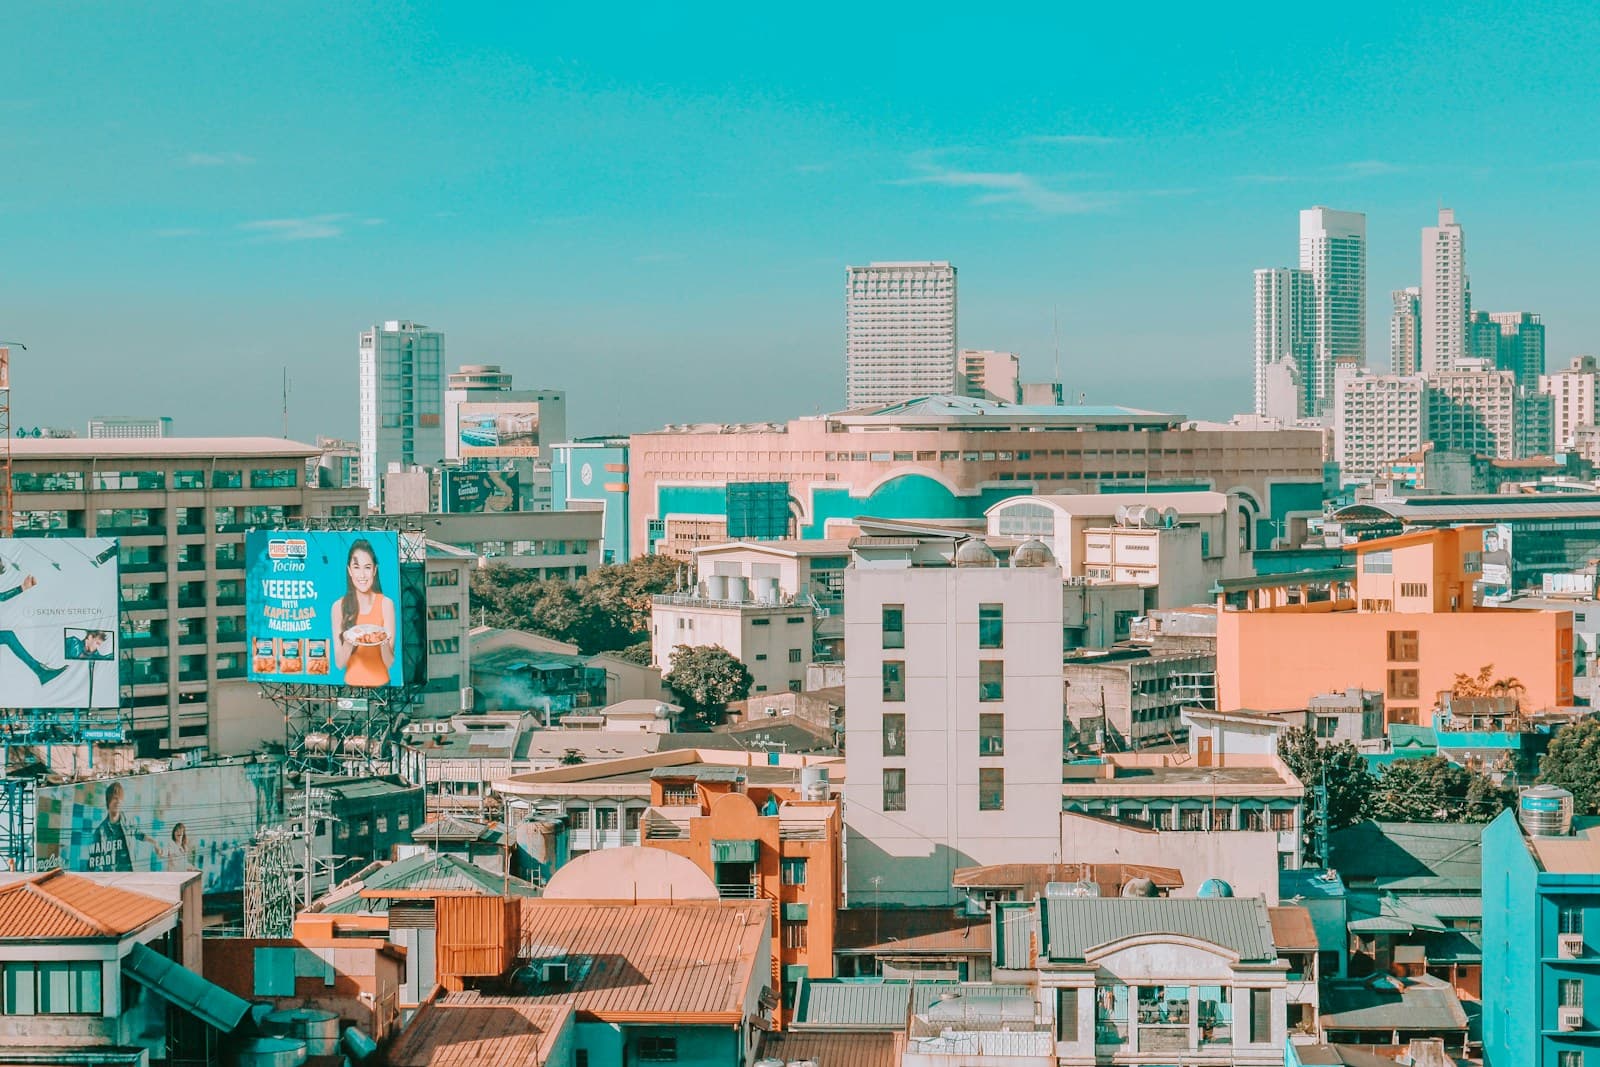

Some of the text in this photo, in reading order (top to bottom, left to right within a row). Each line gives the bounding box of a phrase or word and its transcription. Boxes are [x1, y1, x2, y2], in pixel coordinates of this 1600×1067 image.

[270, 544, 306, 553] PUREFOODS
[272, 560, 305, 573] Tocino
[262, 579, 318, 600] YEEEEES,
[281, 599, 299, 609] WITH
[36, 608, 65, 616] SKINNY
[67, 607, 102, 616] STRETCH
[263, 604, 317, 620] KAPIT-LASA
[268, 619, 312, 632] MARINADE
[89, 840, 123, 854] WANDER
